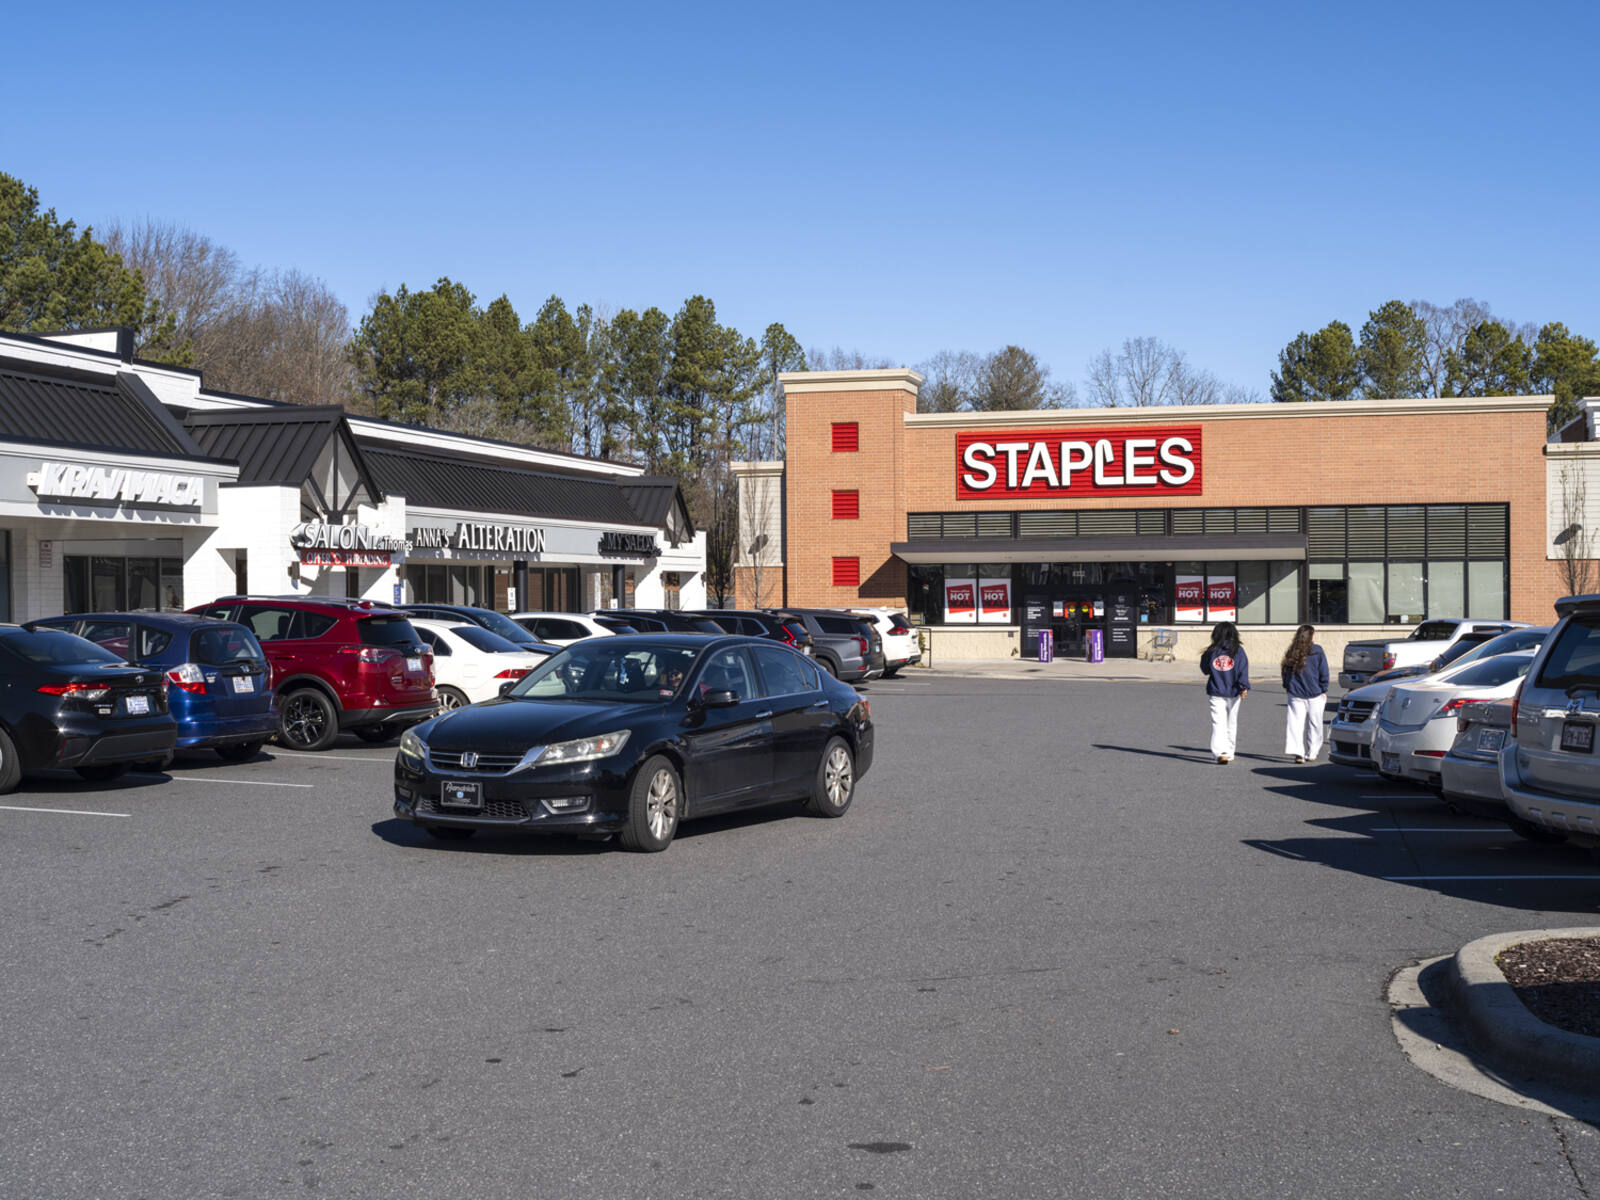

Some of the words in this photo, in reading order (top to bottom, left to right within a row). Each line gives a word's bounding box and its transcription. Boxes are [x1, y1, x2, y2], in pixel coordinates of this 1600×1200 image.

[963, 437, 1195, 489] STAPLES
[37, 463, 126, 499] KRAV
[304, 525, 368, 550] SALON
[416, 527, 450, 548] ANNA'S
[458, 523, 546, 553] ALTERATION
